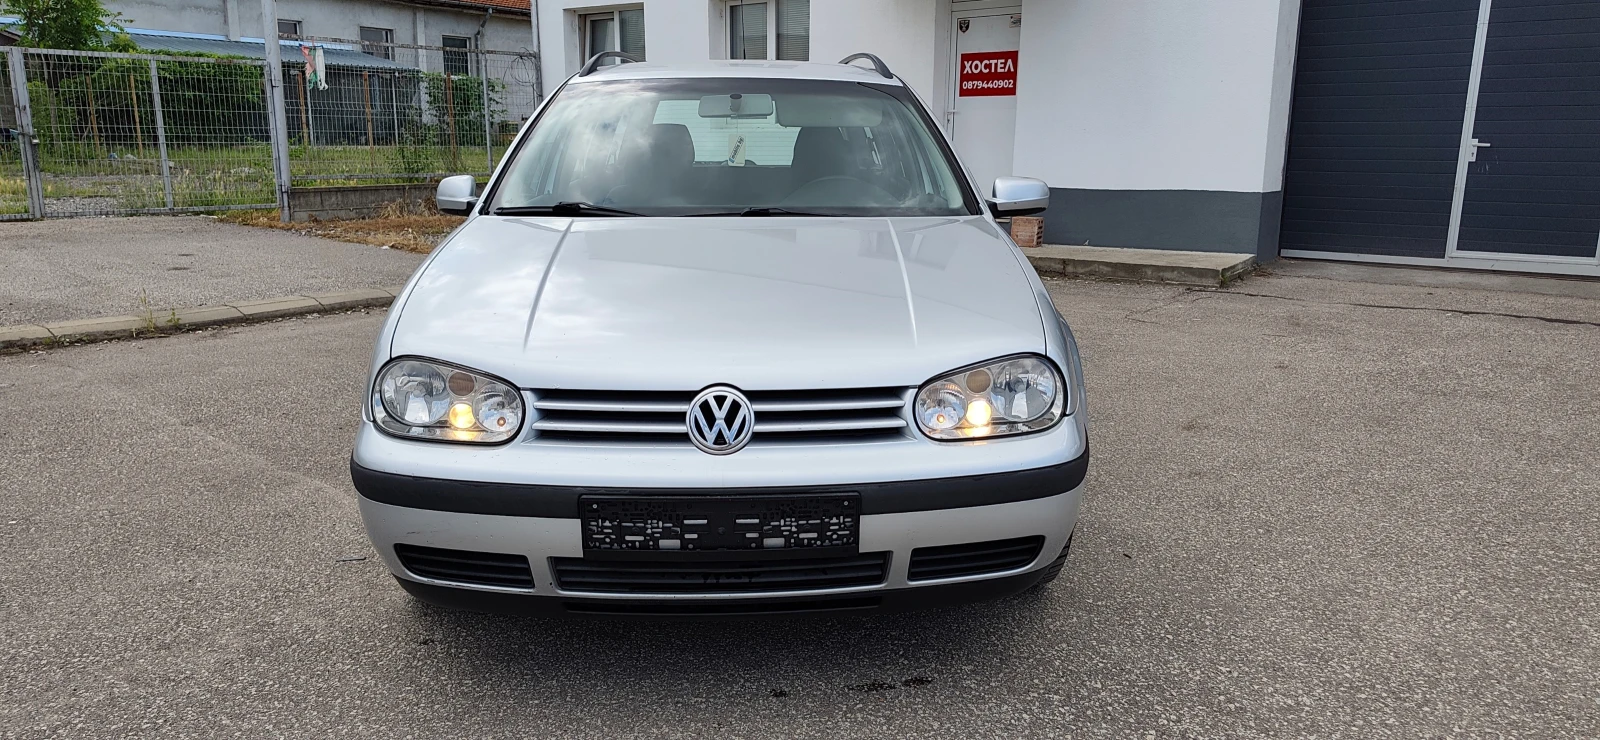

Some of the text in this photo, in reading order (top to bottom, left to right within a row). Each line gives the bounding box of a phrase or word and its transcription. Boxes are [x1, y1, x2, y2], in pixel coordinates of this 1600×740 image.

[963, 59, 1014, 74] ХОСТЕЛ
[962, 80, 1014, 89] 0879440902
[690, 390, 751, 450] VW
